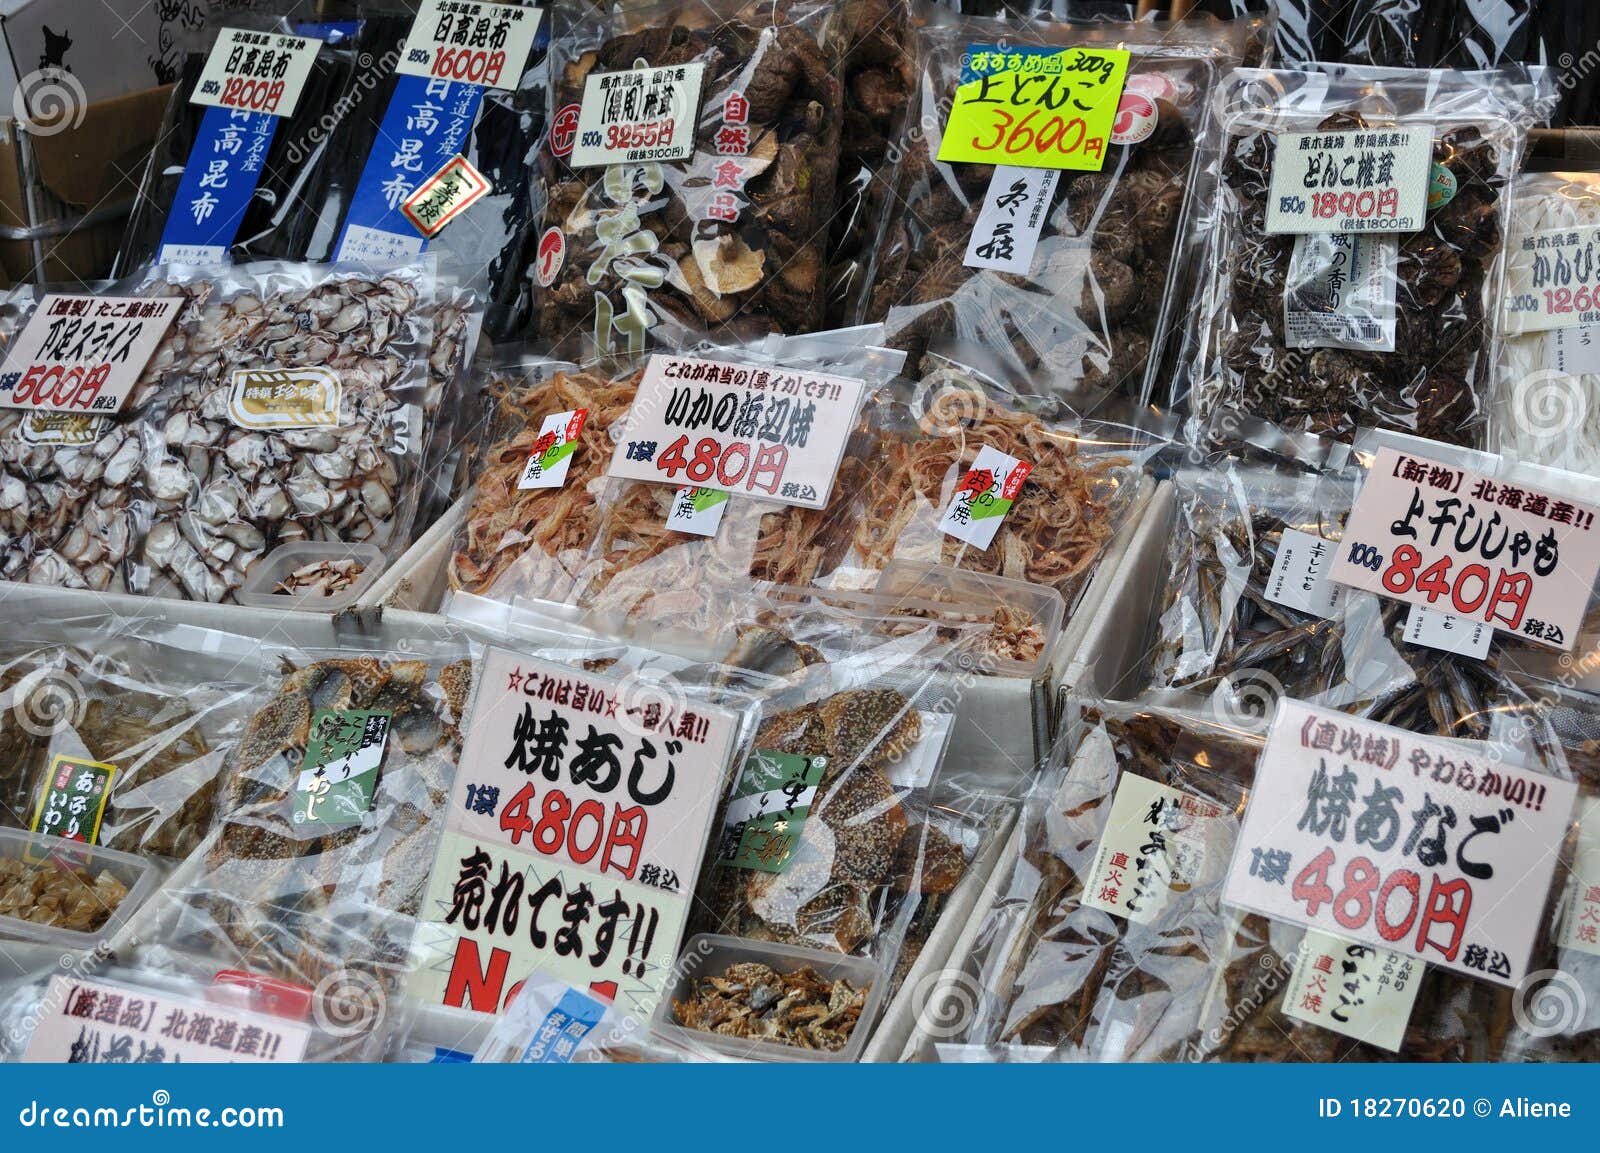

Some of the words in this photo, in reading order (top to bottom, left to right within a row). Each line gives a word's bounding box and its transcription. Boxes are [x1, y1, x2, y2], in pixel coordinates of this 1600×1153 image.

[434, 13, 511, 49] 日高昆布
[436, 2, 482, 17] 北海道産
[225, 45, 292, 80] 日高昆布
[232, 32, 271, 46] 北海道産
[407, 48, 430, 65] 250g
[431, 46, 506, 86] 1600円
[600, 74, 644, 89] 原木栽培
[653, 68, 685, 84] 国内産
[970, 52, 1063, 73] おすすめ品
[1066, 51, 1115, 83] 300g
[219, 76, 285, 113] 1200円
[963, 74, 1095, 111] 上どんこ
[582, 131, 602, 148] 500g
[605, 118, 675, 151] 3255円
[709, 93, 750, 219] 自然食品
[972, 109, 1103, 159] 3600円
[1299, 136, 1346, 150] 原木栽培
[1354, 134, 1409, 148] 静岡県産!!
[1303, 151, 1396, 188] どんこ椎茸
[1280, 196, 1305, 214] 150g
[1311, 187, 1399, 219] 1890円
[1340, 217, 1414, 230] (税抜1800円)
[1522, 232, 1580, 250] 栃木県産
[1532, 241, 1600, 288] かんぴ
[95, 302, 169, 319] たこ風味!!
[12, 363, 111, 410] 500円
[92, 395, 117, 411] 税込
[664, 387, 817, 449] いかの浜辺焼
[626, 441, 657, 463] 1袋
[656, 434, 789, 495] 480円
[781, 481, 817, 500] 税込
[1471, 479, 1594, 532] 北海道産!!
[1390, 486, 1559, 577] 上干ししゃも
[1347, 542, 1384, 572] 100g
[1382, 543, 1533, 630] 840円
[1523, 618, 1564, 645] 税込
[504, 702, 683, 806] 焼あじ
[1408, 746, 1547, 811] やわらかい!!
[68, 770, 95, 839] あぶり
[1297, 757, 1513, 879] 焼あなご
[465, 784, 499, 817] 1袋
[500, 781, 648, 880] 480円
[638, 863, 680, 890] 税込
[1098, 851, 1130, 905] 直火焼
[445, 846, 659, 979] 売れてます!!
[1249, 848, 1291, 885] 1袋
[1292, 846, 1473, 962] 480円
[1462, 943, 1511, 979] 税込
[1299, 954, 1335, 1014] 直火焼
[161, 1008, 282, 1061] 北海道産!!
